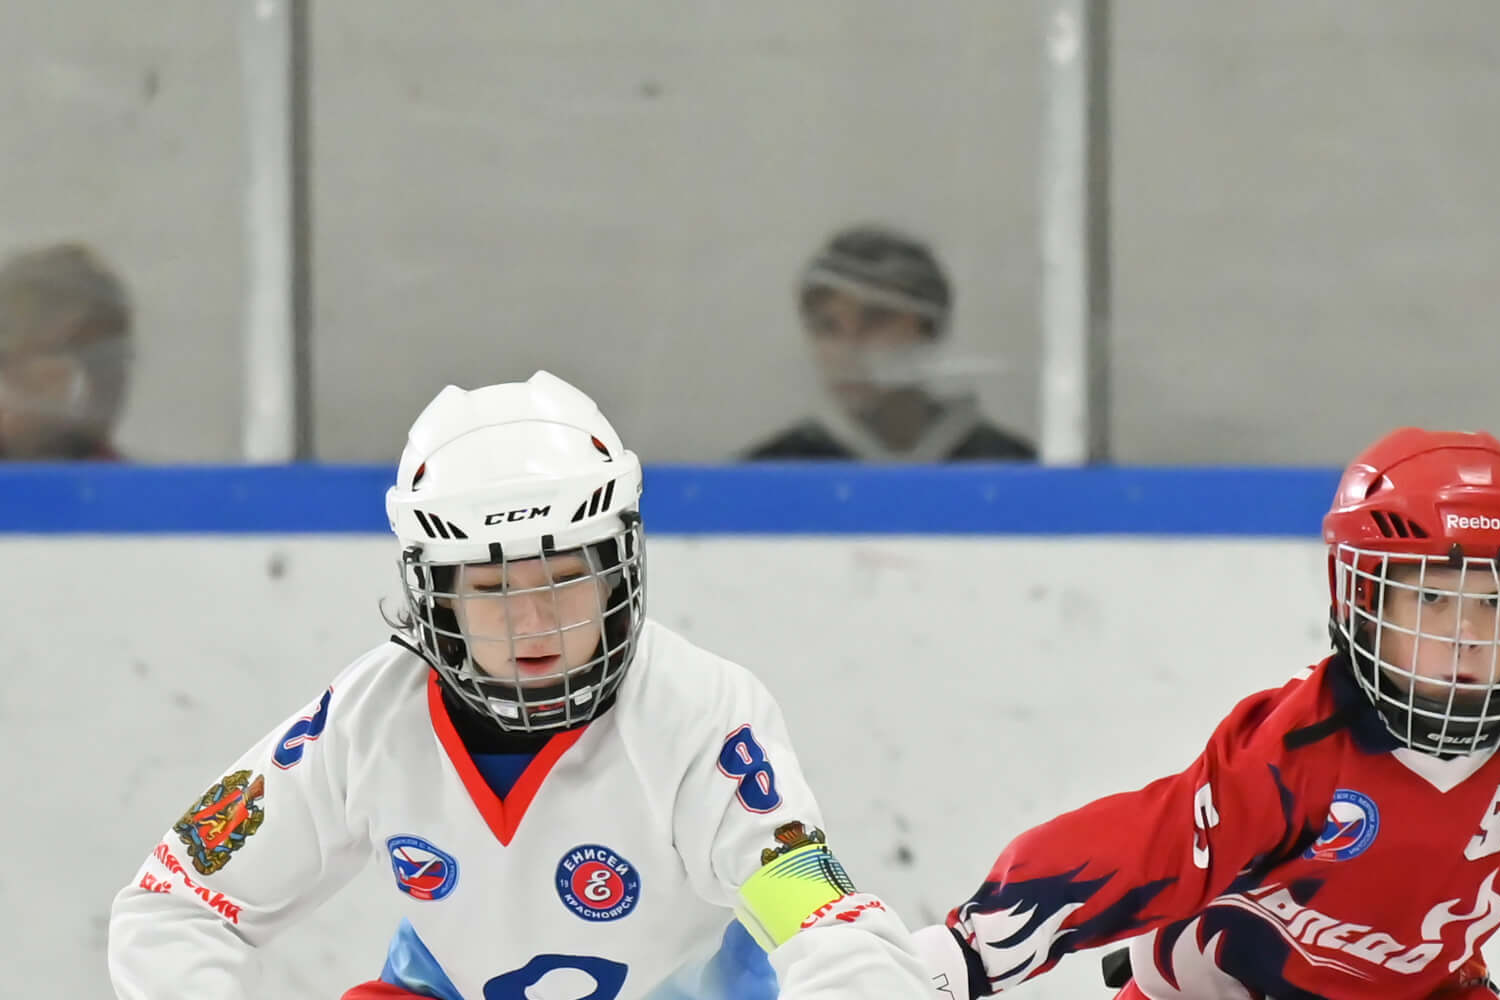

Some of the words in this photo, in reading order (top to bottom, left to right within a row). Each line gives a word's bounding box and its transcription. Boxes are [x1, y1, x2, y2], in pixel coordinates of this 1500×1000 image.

[484, 505, 552, 526] CCM
[717, 723, 783, 814] 8
[562, 848, 630, 876] ЕНИСЕЙ
[564, 893, 635, 919] КРАСНОЯРСК
